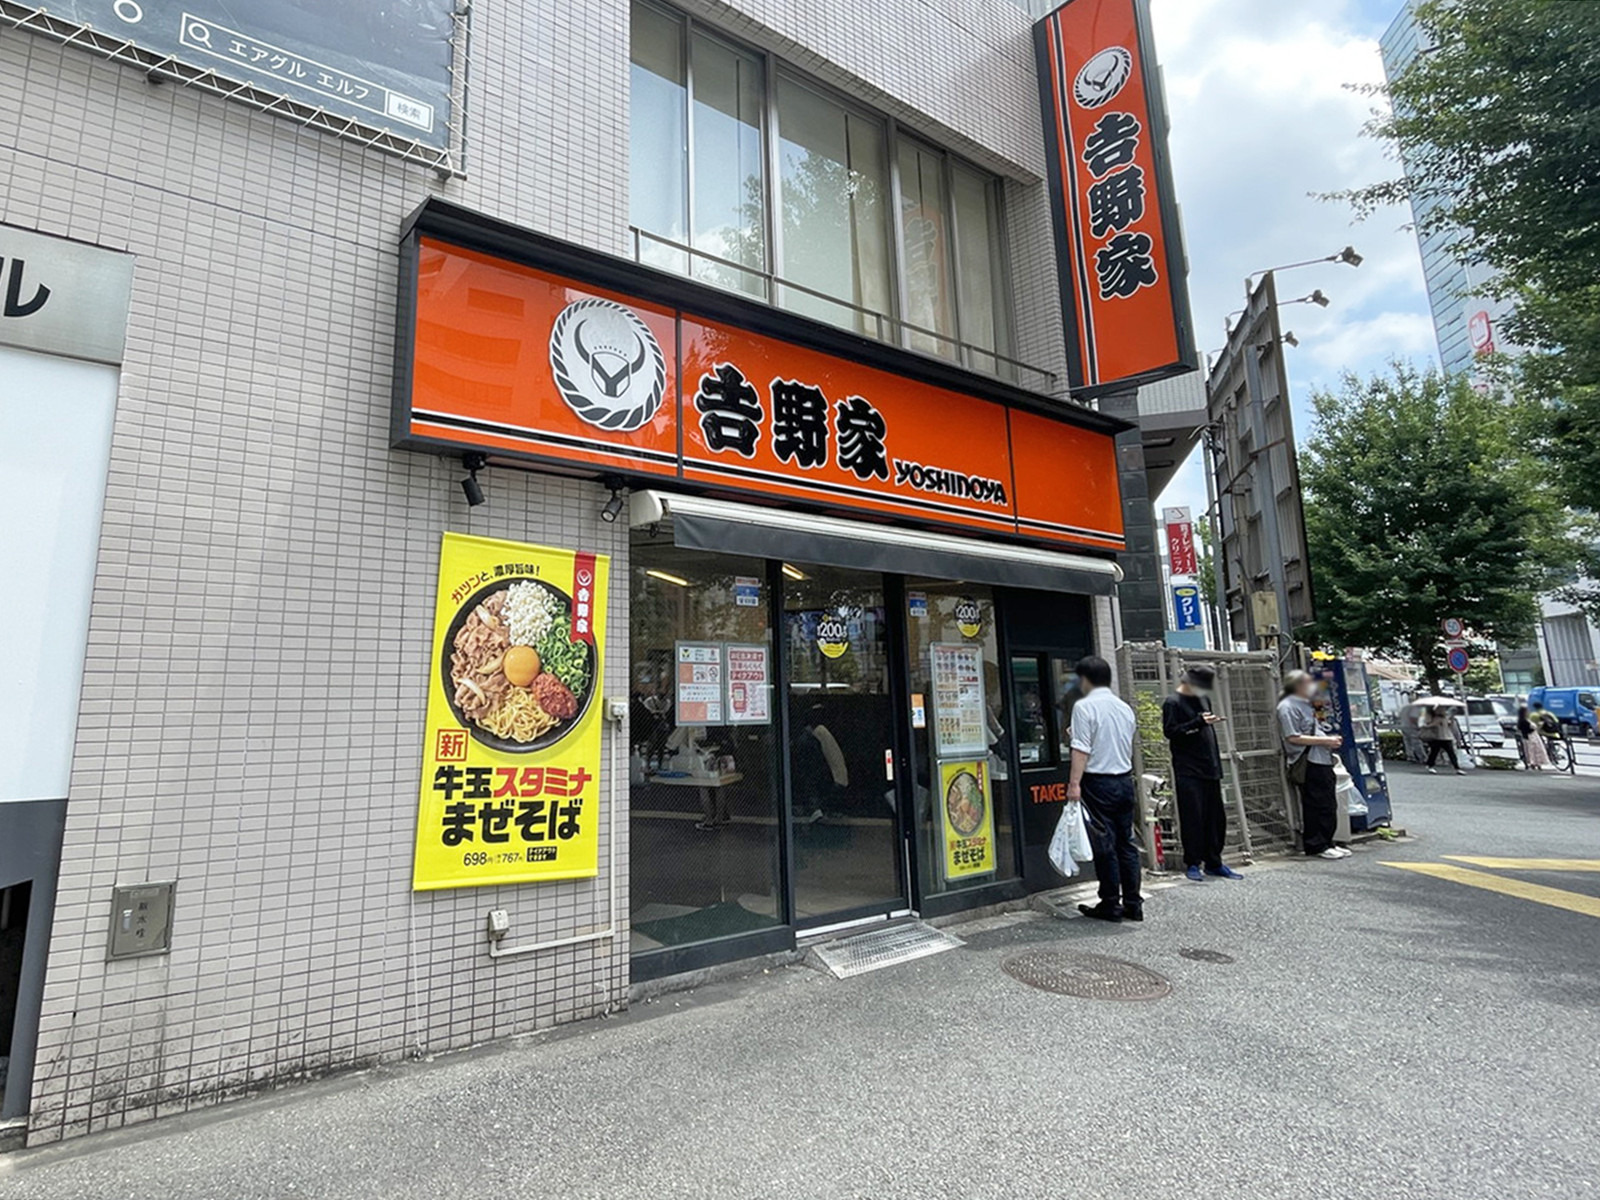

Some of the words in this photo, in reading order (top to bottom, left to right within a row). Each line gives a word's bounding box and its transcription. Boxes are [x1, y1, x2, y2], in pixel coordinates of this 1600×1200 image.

[229, 40, 306, 79] エアグル
[317, 70, 370, 100] エルフ
[1083, 112, 1158, 301] 吉野家
[694, 362, 889, 481] 吉野家
[893, 459, 1009, 505] YOSHINOYA
[1171, 537, 1183, 574] クリニック
[440, 734, 464, 757] 新
[433, 765, 592, 800] 牛玉スタミナ
[1030, 783, 1066, 803] TAKE
[441, 798, 583, 847] まぜそば
